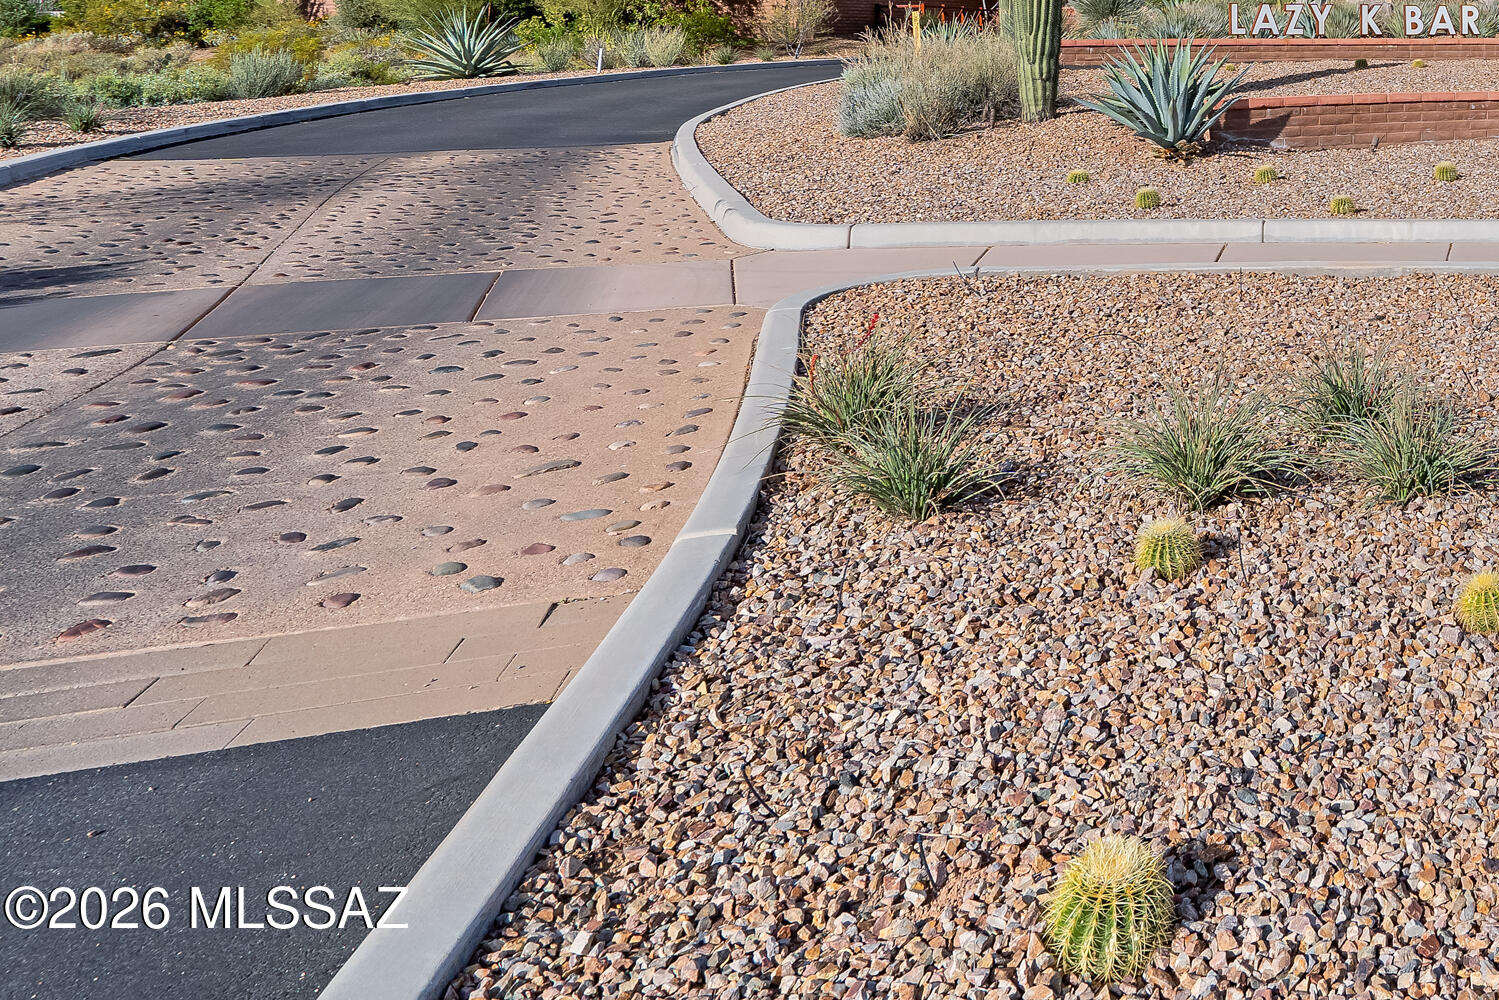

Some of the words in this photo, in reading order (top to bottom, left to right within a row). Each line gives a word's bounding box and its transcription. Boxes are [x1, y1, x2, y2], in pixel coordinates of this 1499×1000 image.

[1229, 2, 1333, 36] LAZY
[1360, 3, 1383, 36] K
[1403, 4, 1480, 36] BAR
